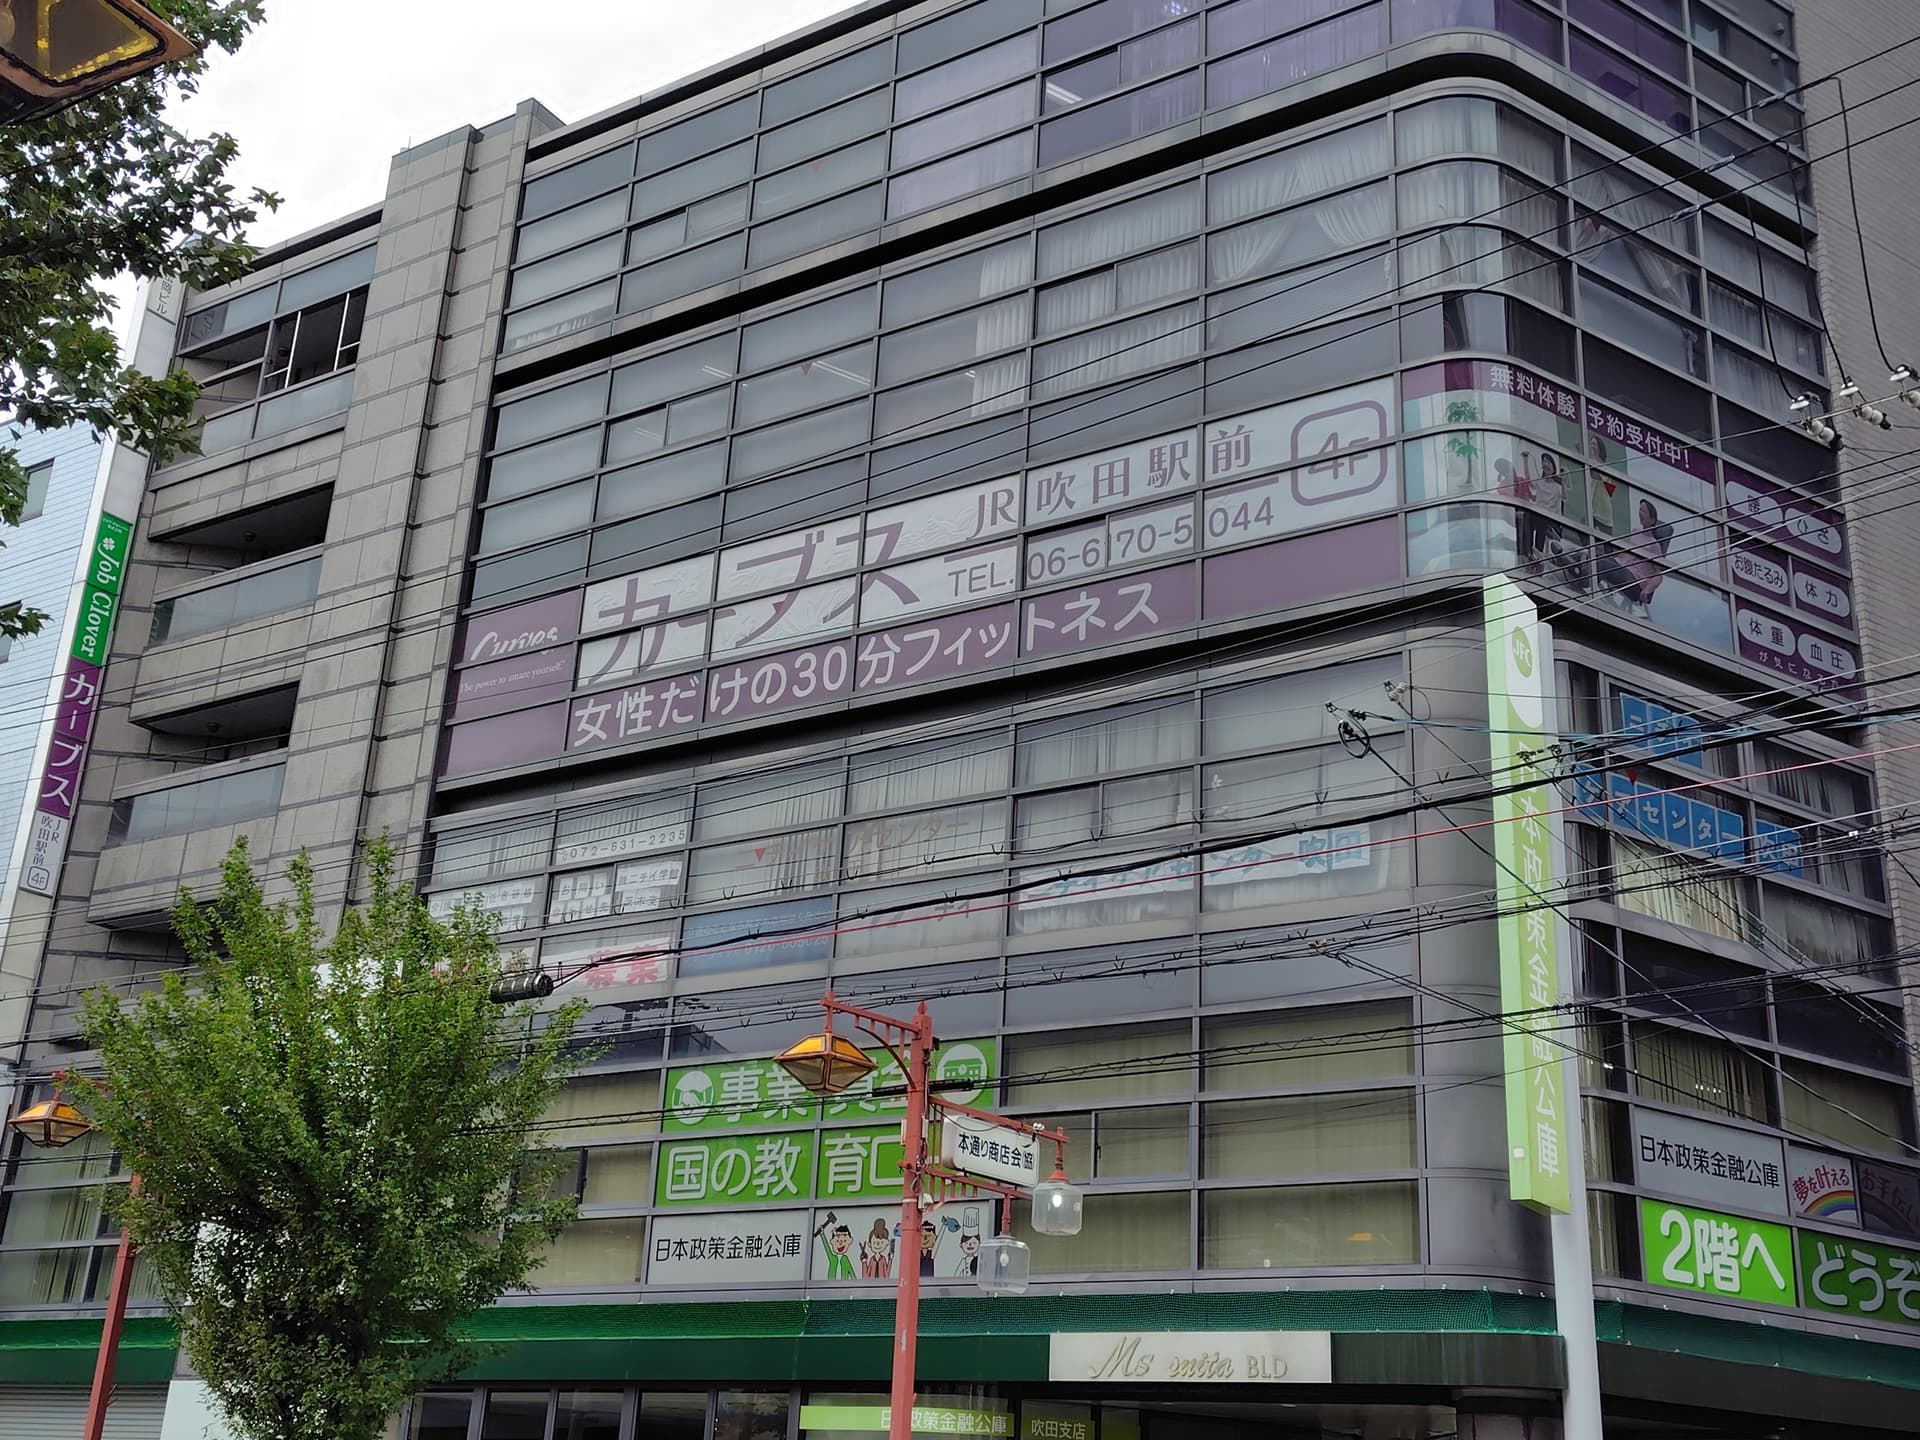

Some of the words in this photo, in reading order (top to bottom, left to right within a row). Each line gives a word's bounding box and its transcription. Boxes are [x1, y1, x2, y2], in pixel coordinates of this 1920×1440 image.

[1490, 365, 1576, 420] 無料体験
[1588, 404, 1690, 469] 予約受付中!
[1307, 431, 1370, 481] 4F
[96, 542, 120, 584] Job
[947, 562, 1015, 598] TEL.
[588, 520, 920, 685] カーブス
[1805, 576, 1838, 608] 体力
[81, 591, 112, 657] Clover
[1749, 616, 1785, 648] 体重
[573, 583, 1159, 747] 女性だけの30分フィットネス
[1513, 638, 1532, 668] JFC
[1810, 642, 1845, 671] 血圧
[41, 673, 95, 806] カーブス
[570, 829, 686, 858] 072-631-2235
[31, 871, 46, 886] 4F
[1640, 1134, 1780, 1189] 日本政策金融公庫
[1792, 1164, 1850, 1206] 夢を叶える
[655, 1233, 801, 1262] 日本政策金融公庫
[1659, 1209, 1786, 1293] 2階へ
[1811, 1241, 1920, 1320] どうぞ
[1247, 1354, 1288, 1379] BLD
[881, 1410, 1007, 1434] 日政策金融公庫
[1031, 1418, 1087, 1440] 吹田支店
